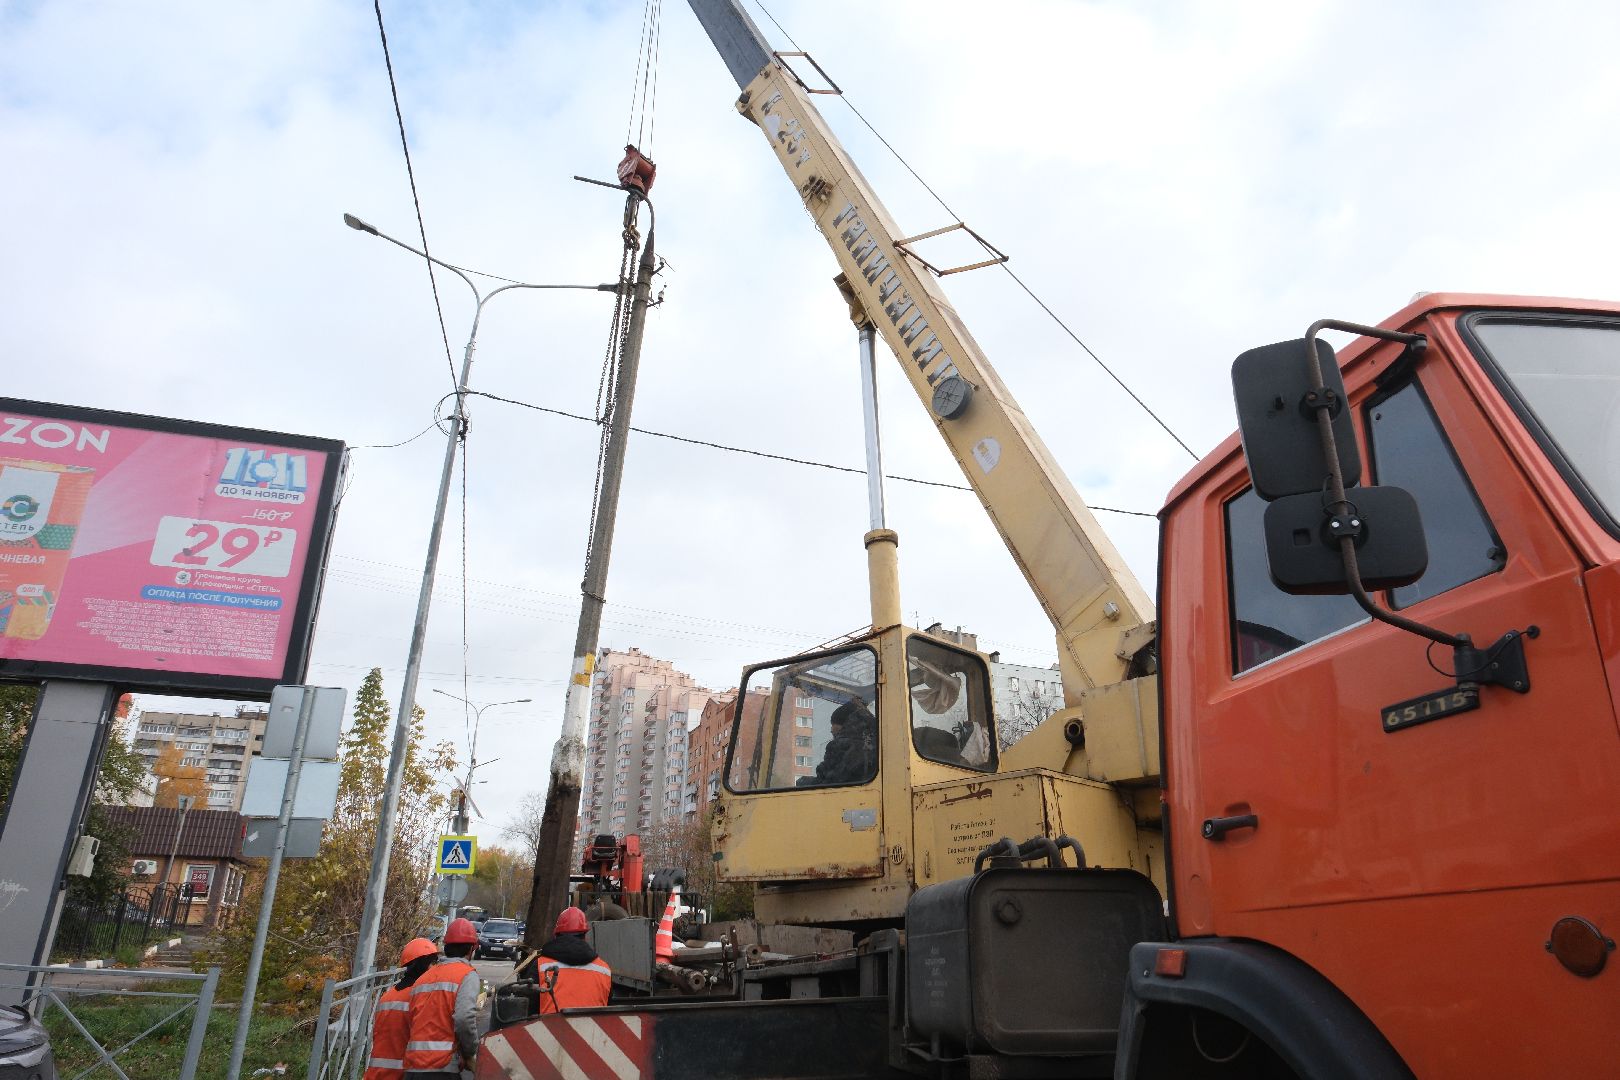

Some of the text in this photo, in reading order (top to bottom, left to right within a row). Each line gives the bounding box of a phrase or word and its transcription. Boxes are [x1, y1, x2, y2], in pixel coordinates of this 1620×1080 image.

[220, 487, 237, 496] ДО
[254, 490, 299, 501] НОЯБРЯ
[0, 522, 35, 531] ТЕПЬ
[148, 588, 279, 607] ОПЛАТА ПОСЛЕ ПОЛУЧЕНИЯ
[1386, 692, 1467, 726] 65115
